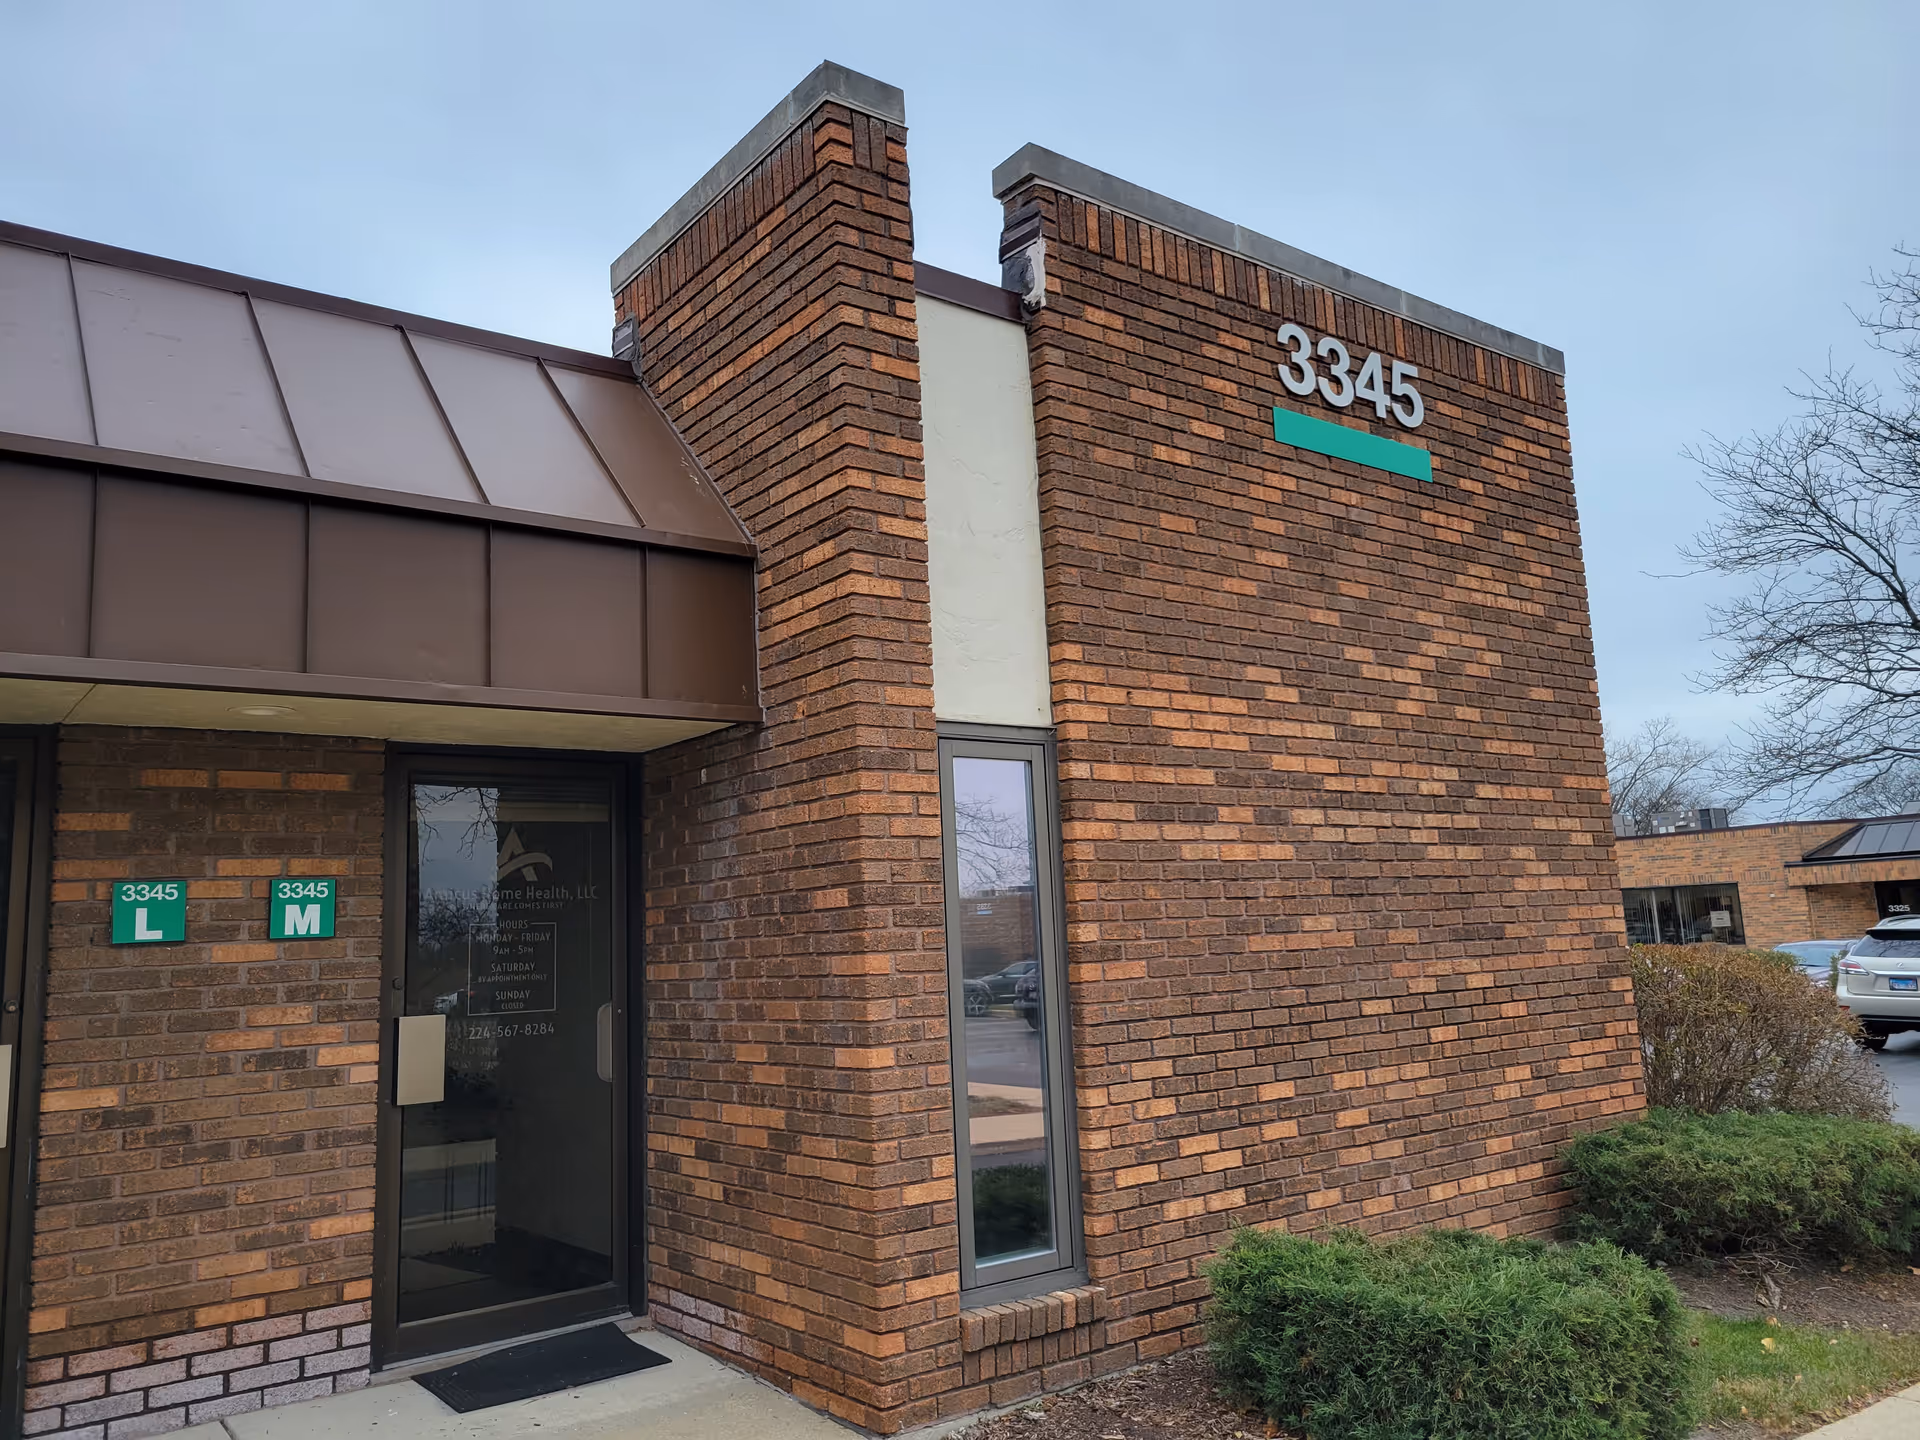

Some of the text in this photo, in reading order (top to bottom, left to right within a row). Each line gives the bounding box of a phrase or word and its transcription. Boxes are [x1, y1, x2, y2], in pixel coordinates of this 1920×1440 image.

[1277, 323, 1425, 428] 3345
[121, 883, 179, 901] 3345
[278, 882, 329, 898] 3345
[526, 884, 573, 901] Health,
[577, 884, 599, 899] LLC
[1888, 904, 1911, 913] 3325
[134, 907, 163, 940] L
[284, 904, 321, 936] M
[499, 919, 529, 930] HOURS
[475, 933, 513, 944] MONDAY
[521, 932, 551, 942] FRIDAY
[492, 945, 510, 955] 9AM
[518, 944, 534, 955] 5PM
[491, 962, 536, 973] SATURDAY
[487, 974, 530, 983] APPOINTMENT
[496, 990, 531, 1001] SUNDAY
[501, 1002, 525, 1010] CLOSED
[468, 1022, 555, 1040] 224-567-8284
